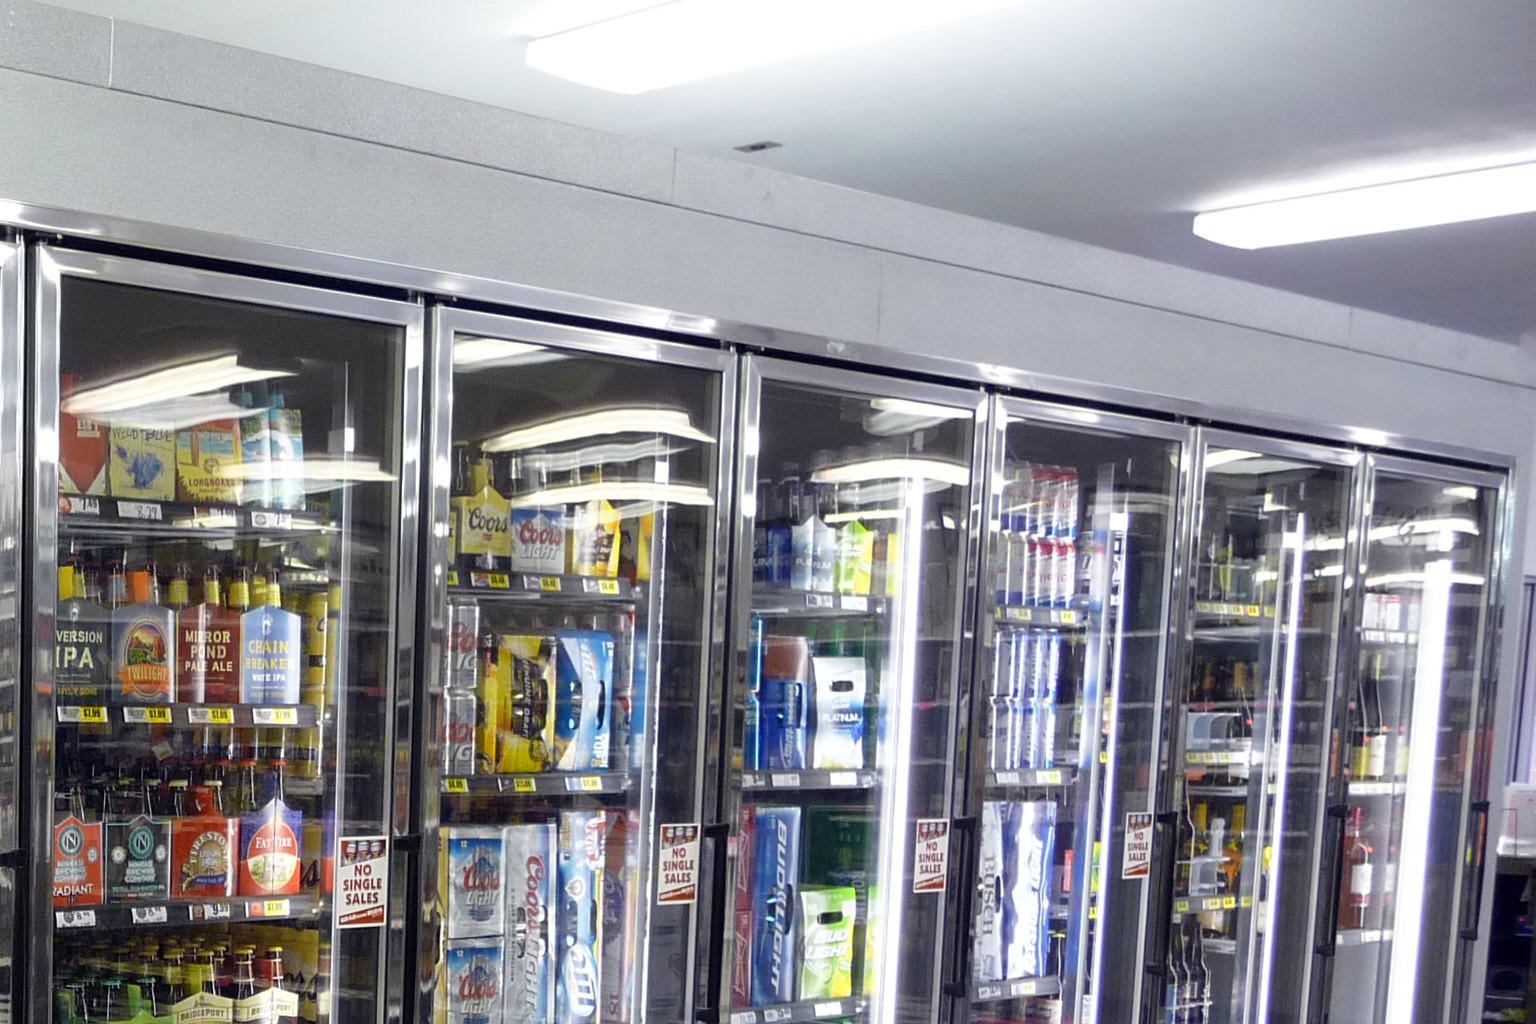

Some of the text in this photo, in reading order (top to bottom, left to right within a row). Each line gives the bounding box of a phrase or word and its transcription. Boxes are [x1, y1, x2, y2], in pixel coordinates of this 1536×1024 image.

[468, 507, 508, 533] Coors
[519, 519, 562, 545] Coors
[520, 546, 560, 561] LIGHT
[190, 645, 227, 660] POND
[248, 639, 290, 654] CHAIN
[56, 647, 95, 669] IPA
[184, 660, 233, 672] PALE ALE
[255, 836, 274, 849] FAT
[1133, 832, 1145, 841] NO
[671, 847, 687, 859] NO
[926, 841, 938, 852] NO
[1127, 841, 1150, 852] SINGLE
[918, 852, 944, 863] SINGLE
[1127, 851, 1147, 863] SALES
[354, 864, 372, 877] NO
[662, 859, 695, 872] SINGLE
[919, 863, 941, 874] SALES
[343, 877, 383, 891] SINGLE
[463, 866, 501, 892] Coors
[664, 872, 692, 884] SALES
[345, 892, 379, 906] SALES
[466, 891, 501, 907] LIGHT
[982, 854, 996, 936] BUSCH
[770, 818, 788, 996] BUD LIGHT
[525, 854, 545, 1012] Coors LIGHT
[815, 928, 848, 943] BUD
[458, 975, 497, 1000] Coors
[461, 1000, 495, 1015] LIGHT
[179, 1008, 226, 1022] BRIDGEPORT
